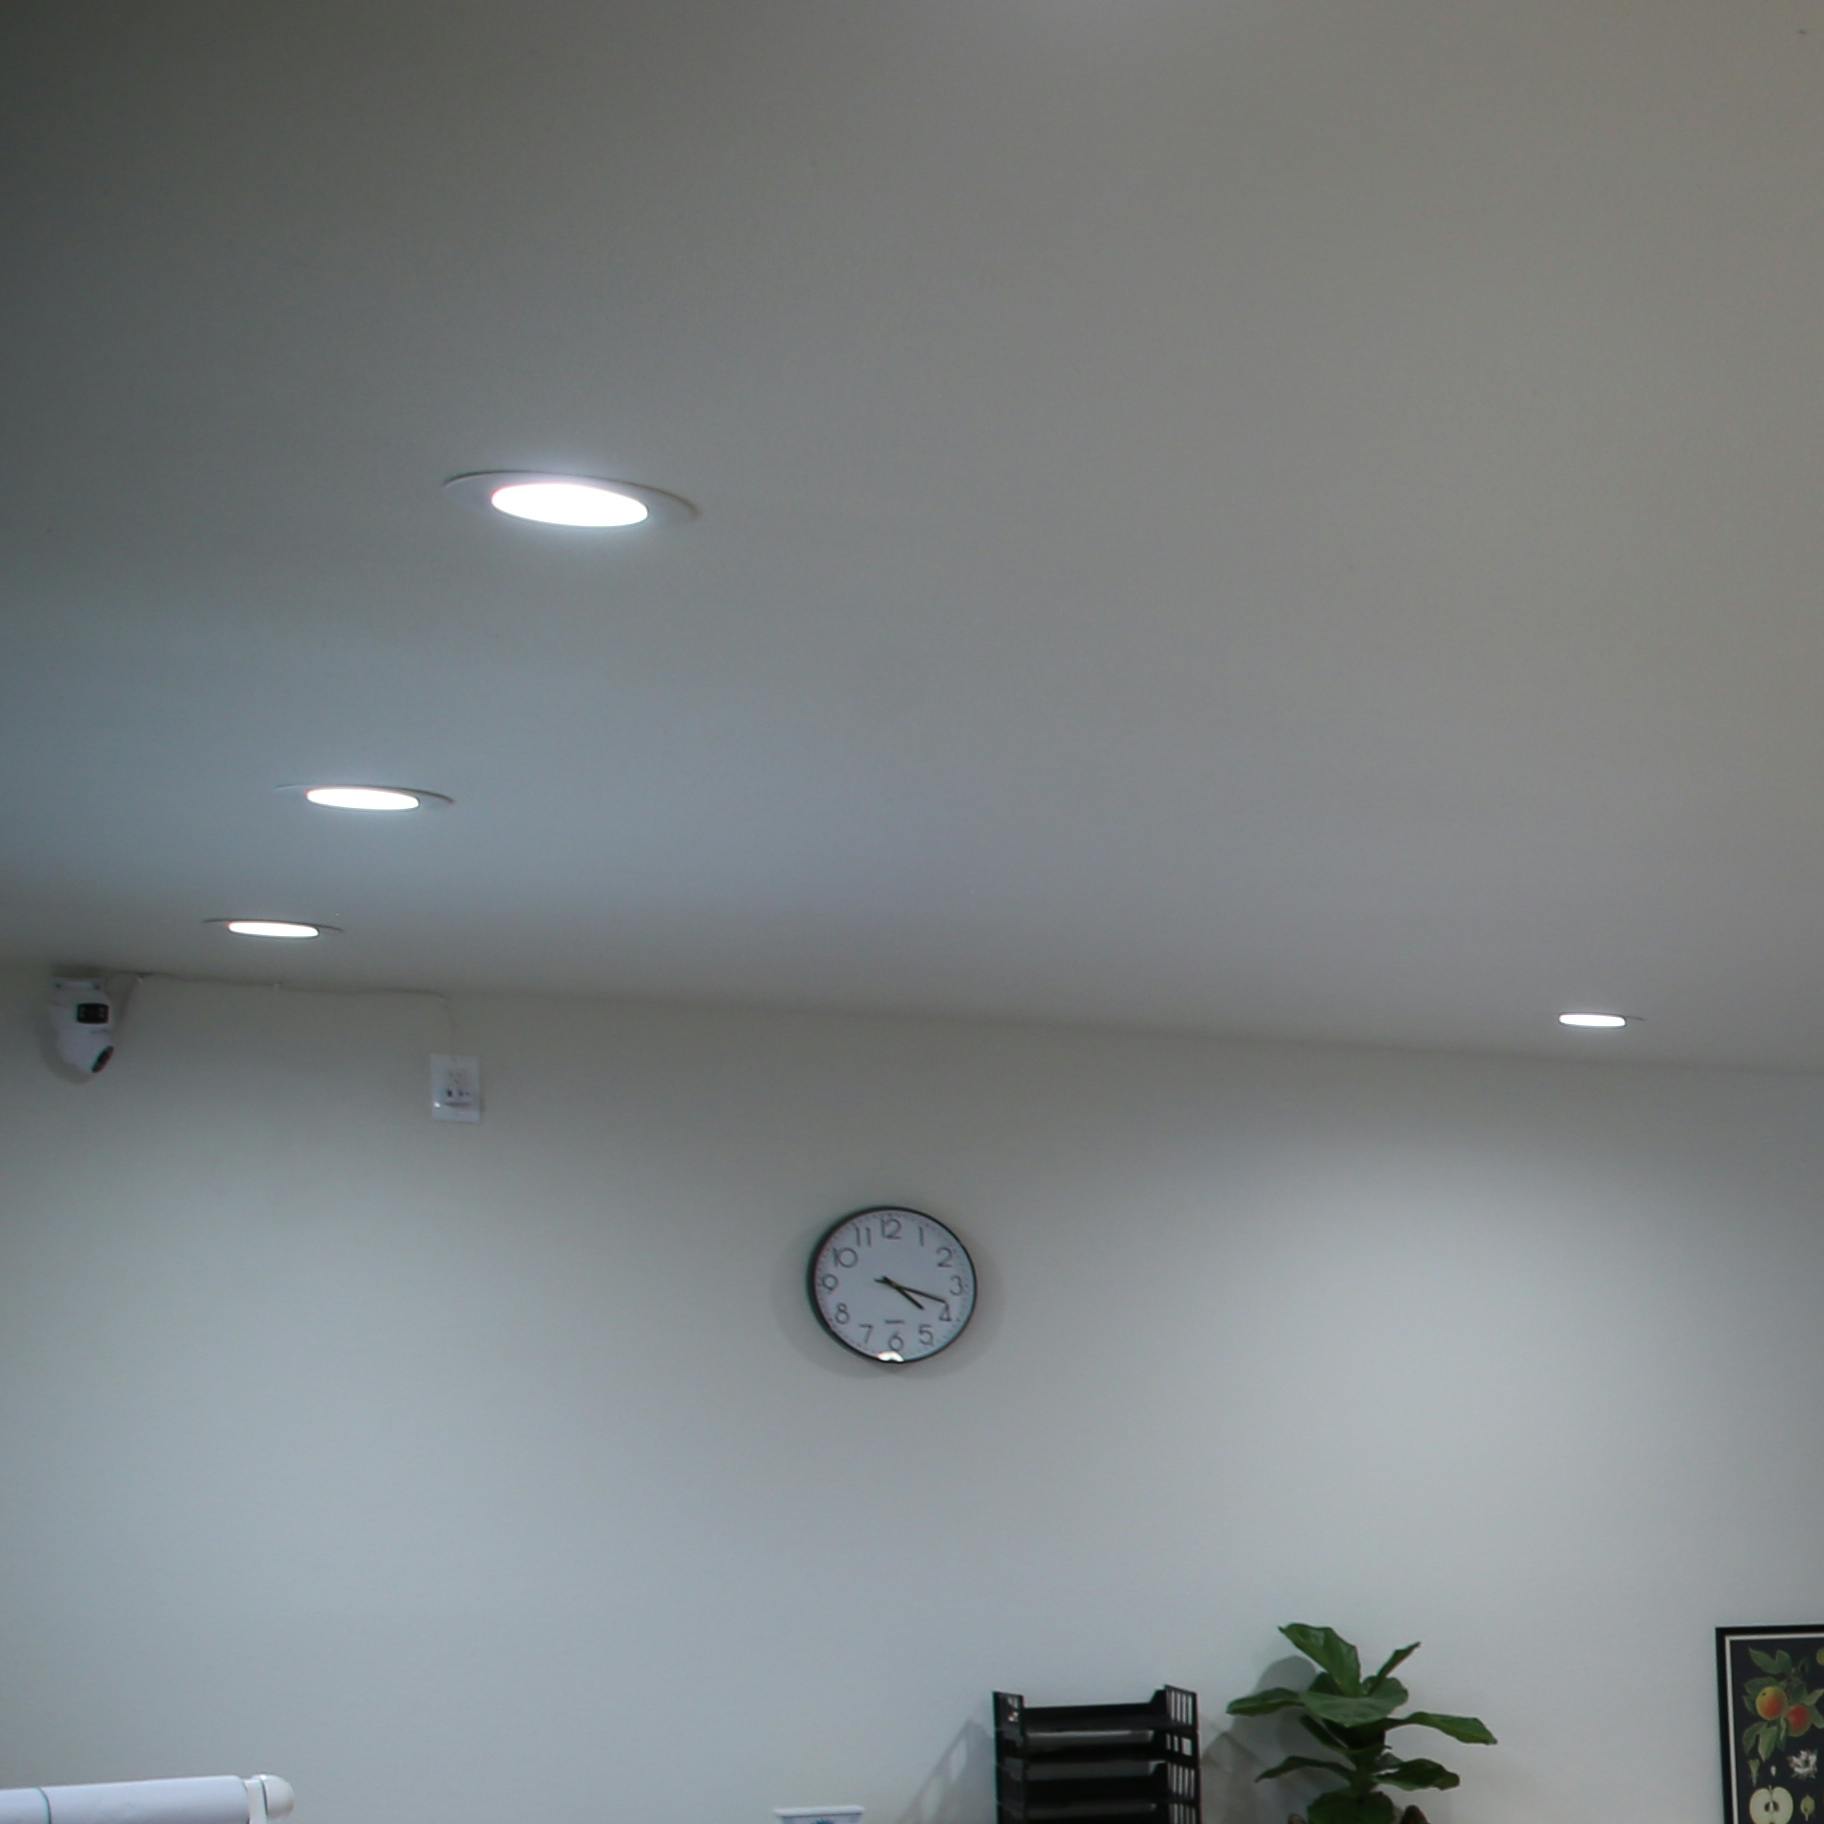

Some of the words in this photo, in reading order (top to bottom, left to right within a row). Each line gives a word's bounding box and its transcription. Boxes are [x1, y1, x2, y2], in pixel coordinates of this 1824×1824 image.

[855, 1227, 871, 1247] 11
[880, 1218, 902, 1240] 12
[918, 1226, 925, 1247] 1
[833, 1247, 858, 1269] 10
[936, 1246, 953, 1268] 2
[822, 1273, 839, 1292] 9
[949, 1275, 964, 1296] 3
[835, 1302, 850, 1325] 8
[938, 1300, 952, 1322] 4
[859, 1324, 874, 1344] 7
[888, 1330, 904, 1352] 6
[918, 1324, 934, 1346] 5
